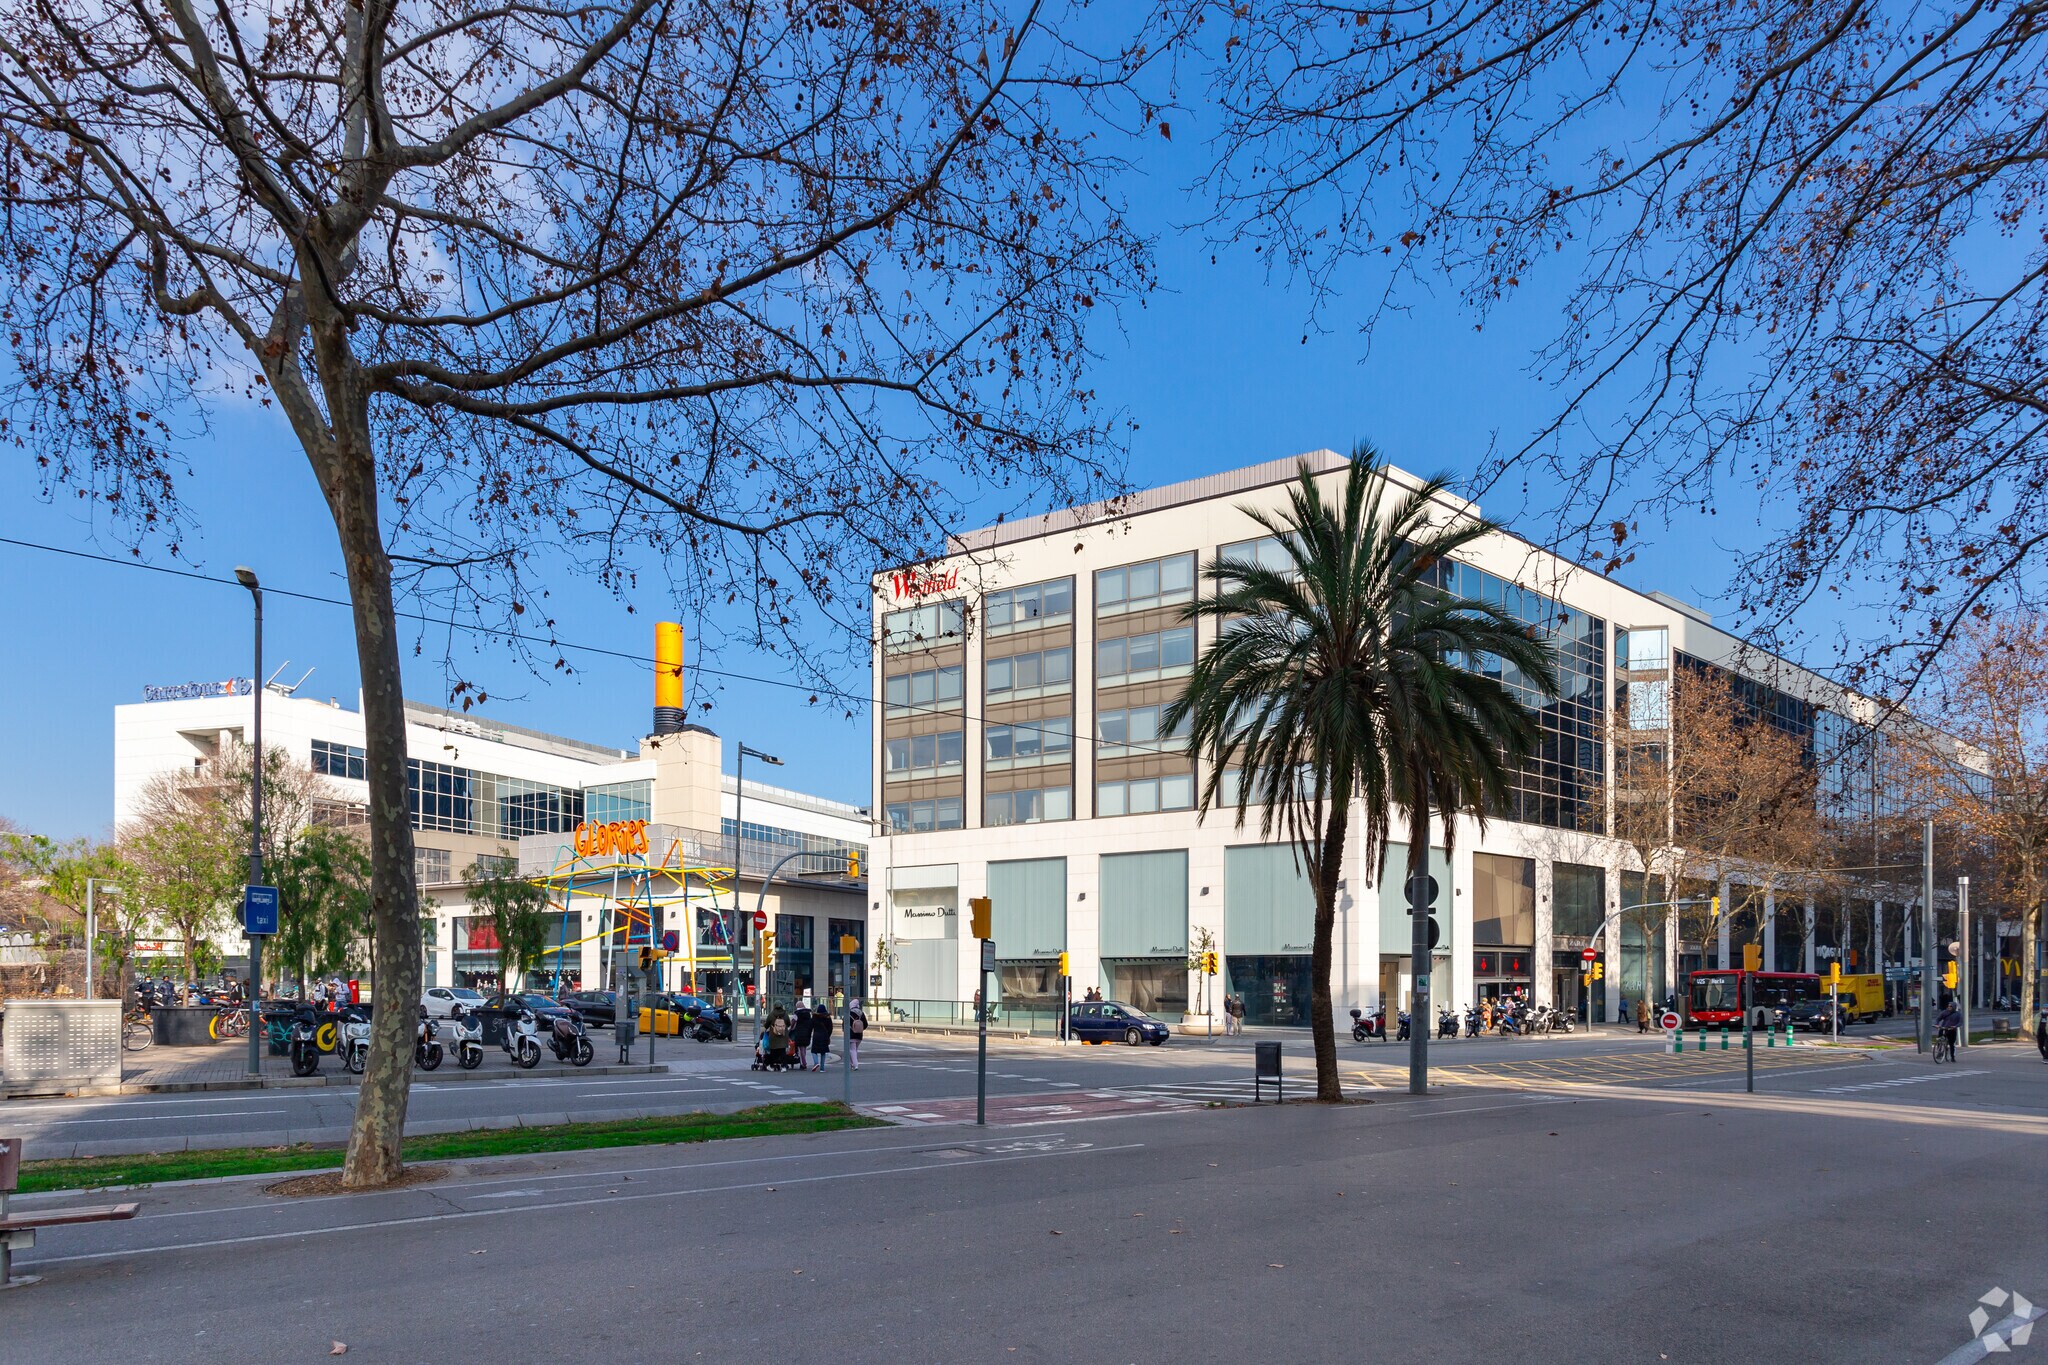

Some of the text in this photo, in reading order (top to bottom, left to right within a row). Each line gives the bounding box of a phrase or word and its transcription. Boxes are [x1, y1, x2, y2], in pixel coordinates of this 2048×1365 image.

[143, 681, 222, 701] Carrefour
[904, 906, 957, 918] Massimo Dutti
[256, 915, 269, 925] taxi
